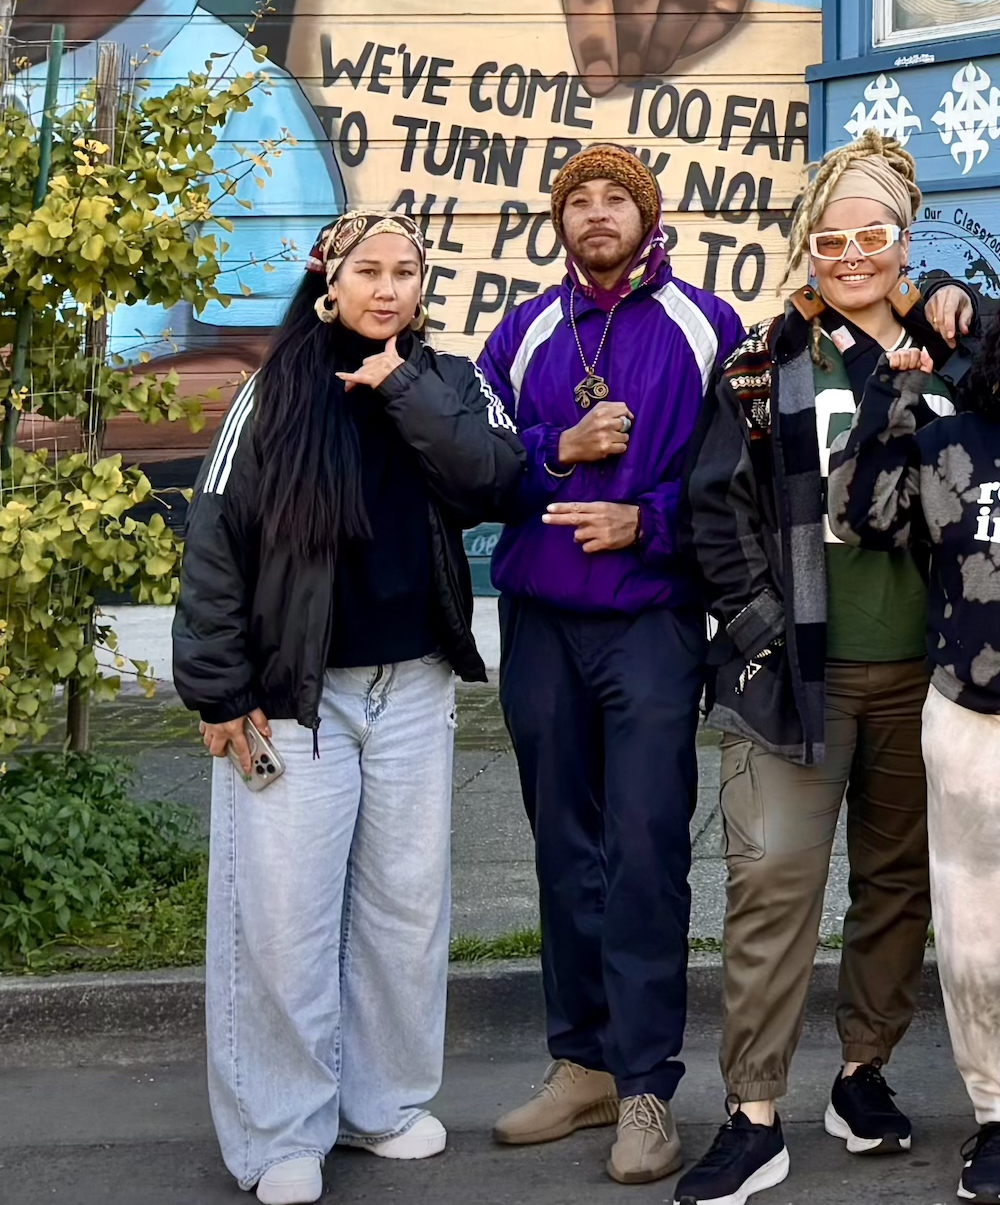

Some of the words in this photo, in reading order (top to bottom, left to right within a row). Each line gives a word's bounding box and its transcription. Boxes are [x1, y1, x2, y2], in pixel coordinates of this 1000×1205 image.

[320, 34, 455, 105] WE'VE
[470, 60, 593, 129] COME
[628, 81, 712, 143] TOO
[718, 95, 809, 163] FAR
[314, 106, 368, 168] TO
[393, 115, 527, 187] TURN
[924, 207, 942, 220] Our
[698, 231, 767, 302] TO
